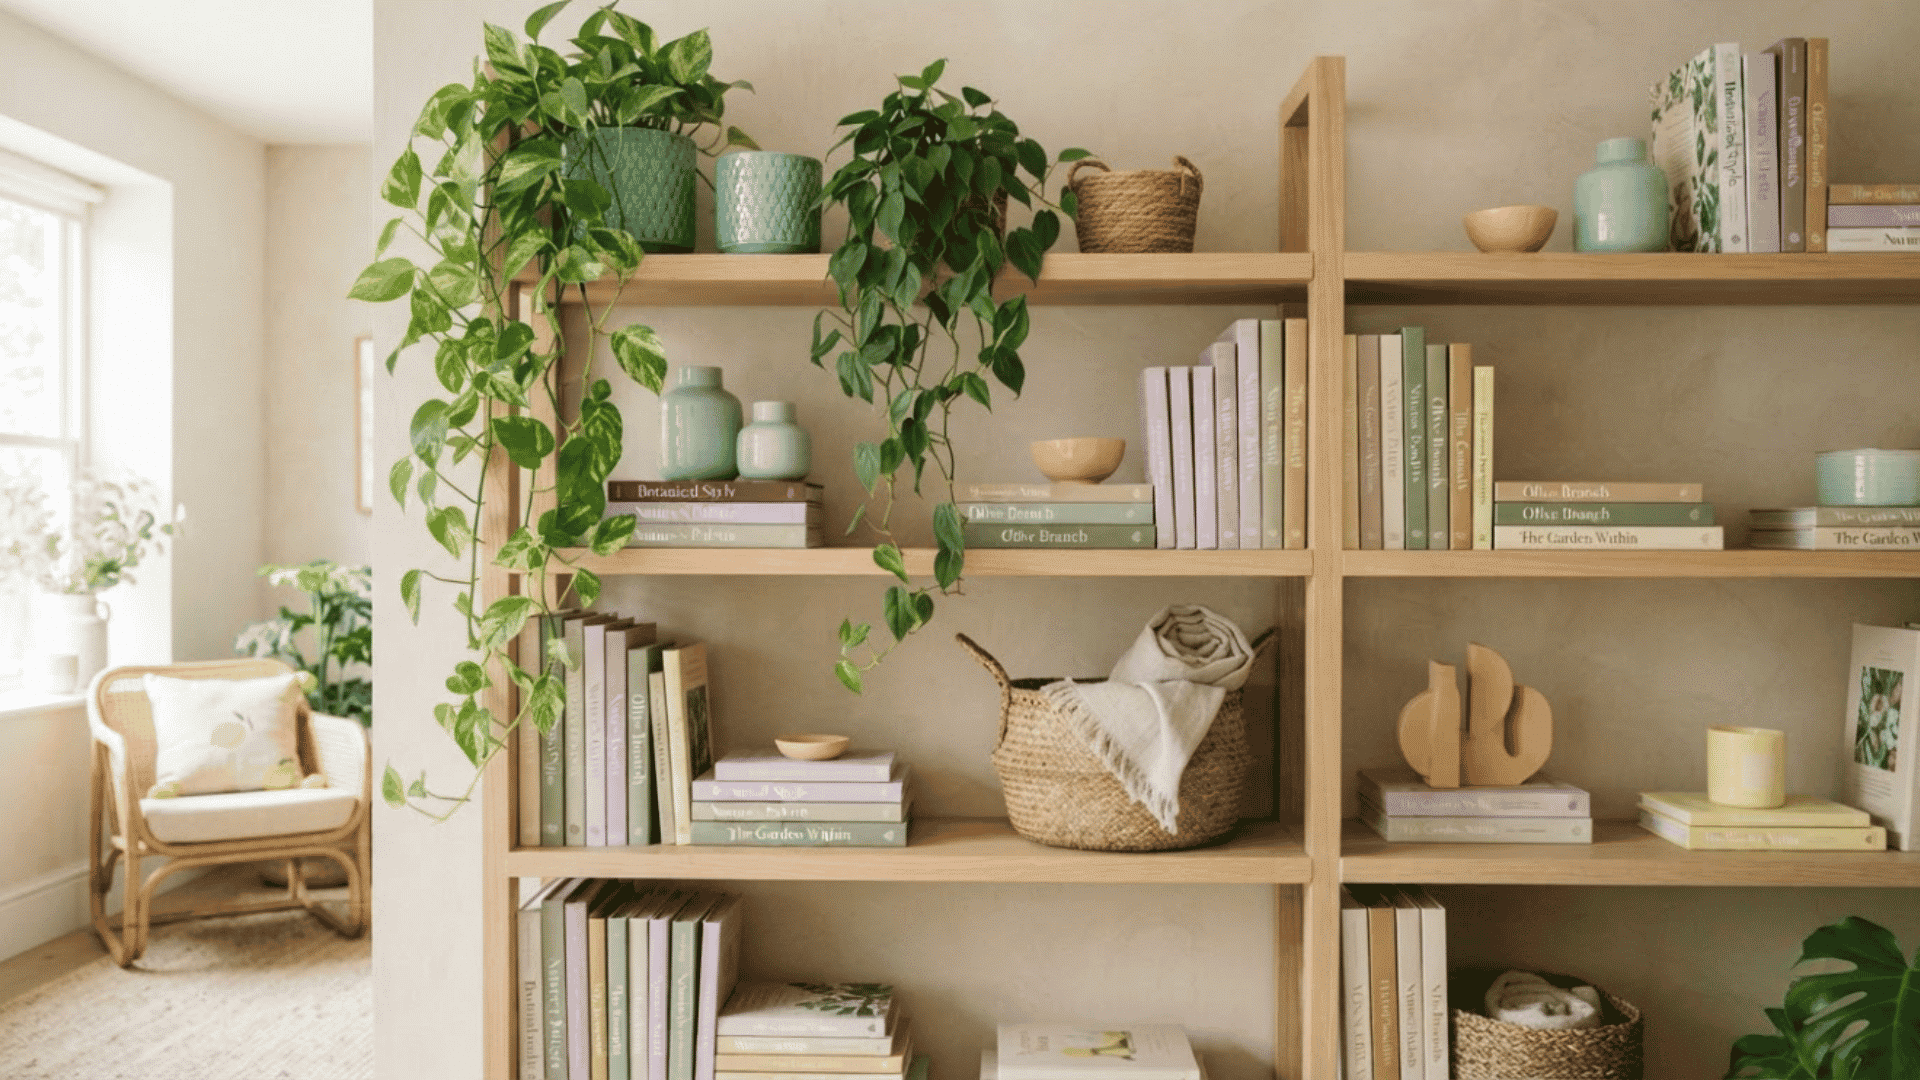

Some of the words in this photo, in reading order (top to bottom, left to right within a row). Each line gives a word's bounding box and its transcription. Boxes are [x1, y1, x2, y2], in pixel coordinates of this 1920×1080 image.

[1519, 530, 1544, 544] The
[1547, 530, 1593, 544] Garden
[1596, 530, 1639, 544] Within
[1833, 531, 1859, 545] The
